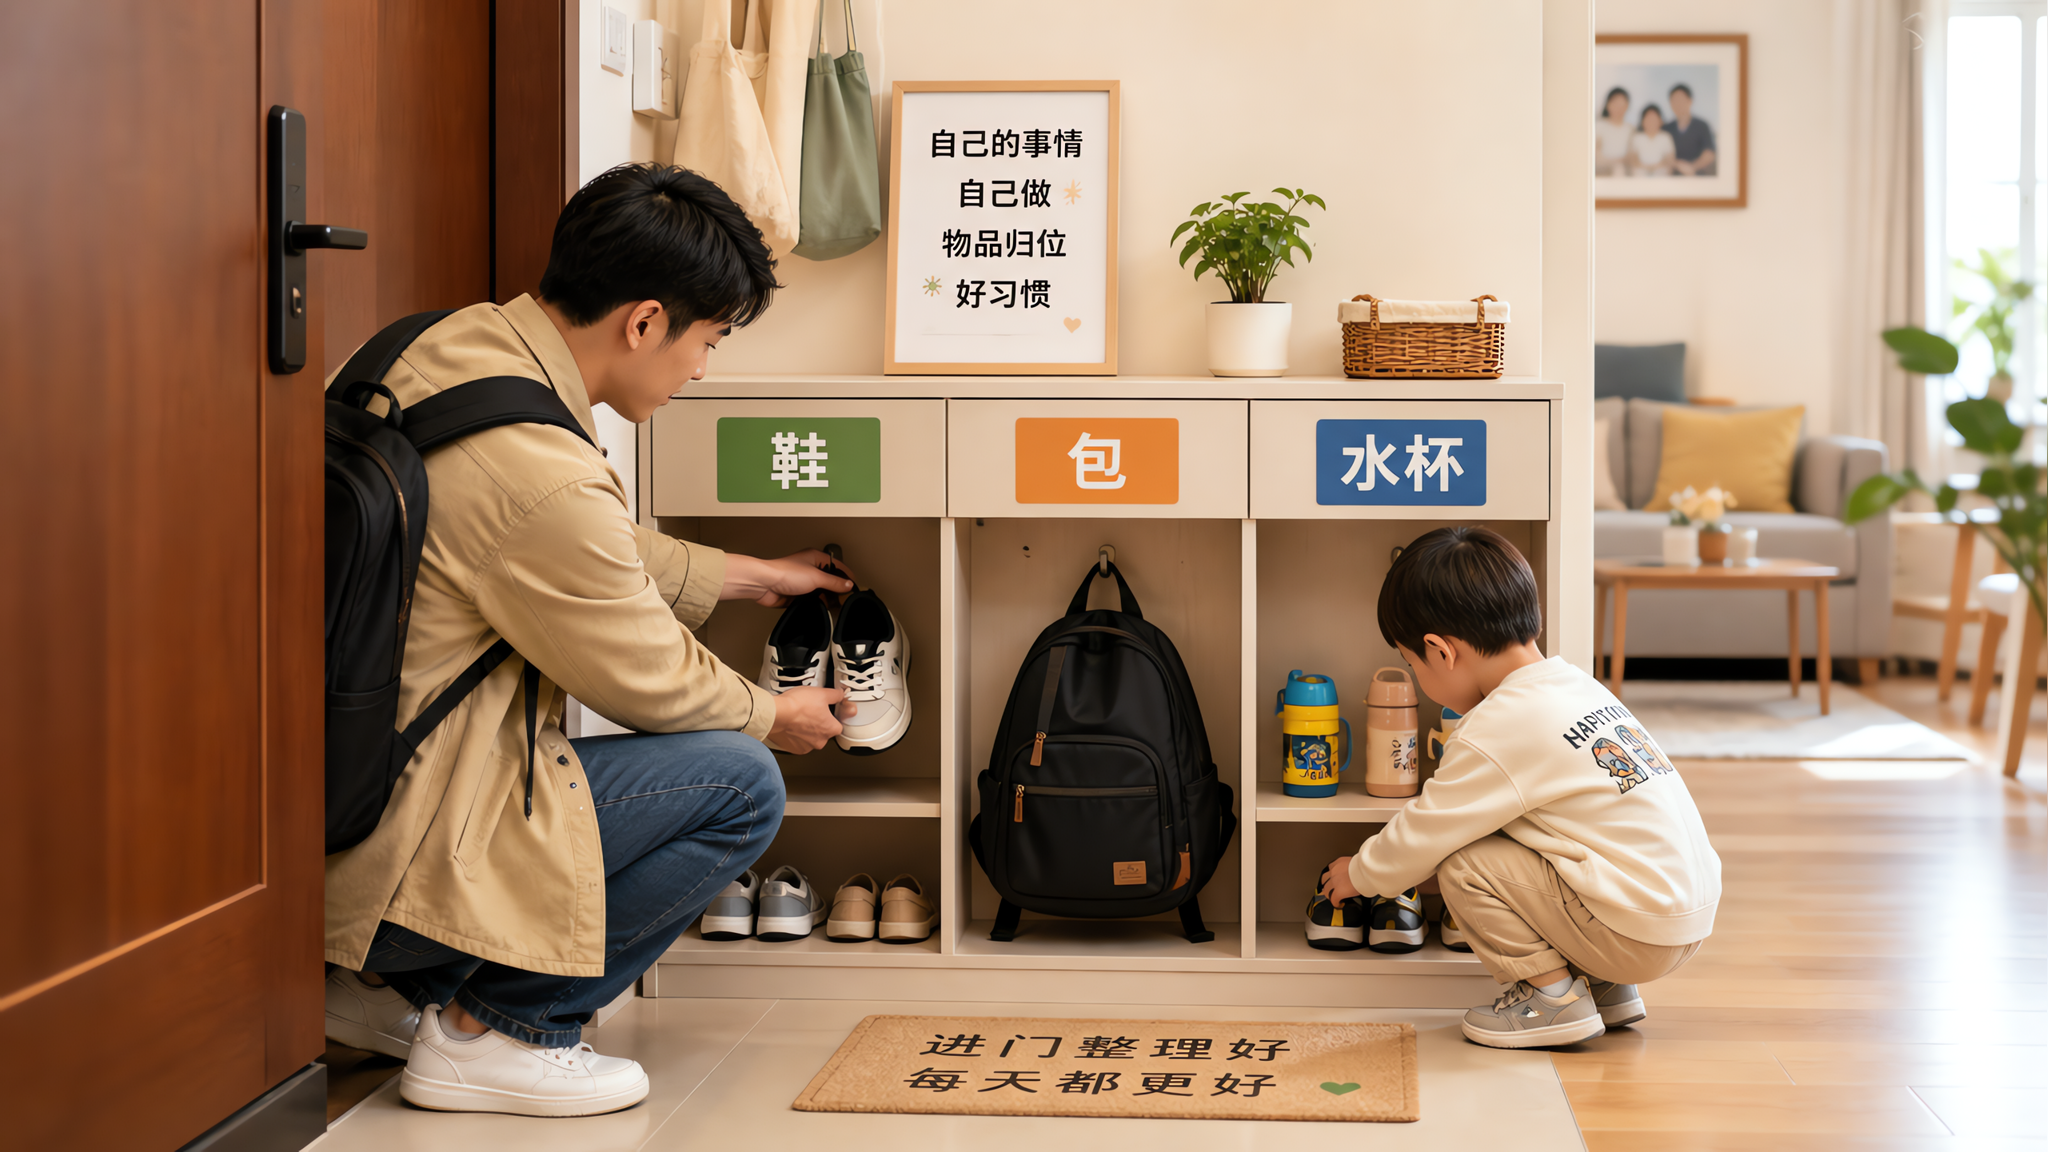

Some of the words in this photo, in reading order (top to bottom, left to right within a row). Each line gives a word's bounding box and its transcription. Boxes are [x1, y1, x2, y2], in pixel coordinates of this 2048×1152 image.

[931, 128, 1083, 159] 自己的事情
[960, 178, 1052, 208] 自己做
[942, 228, 1067, 259] 物品归位
[956, 278, 1051, 309] 好习惯
[770, 432, 829, 490] 鞋
[1067, 432, 1127, 490] 包
[1340, 434, 1465, 492] 水杯
[919, 1033, 1291, 1062] 进门整理好
[903, 1067, 1276, 1098] 每天都更好
